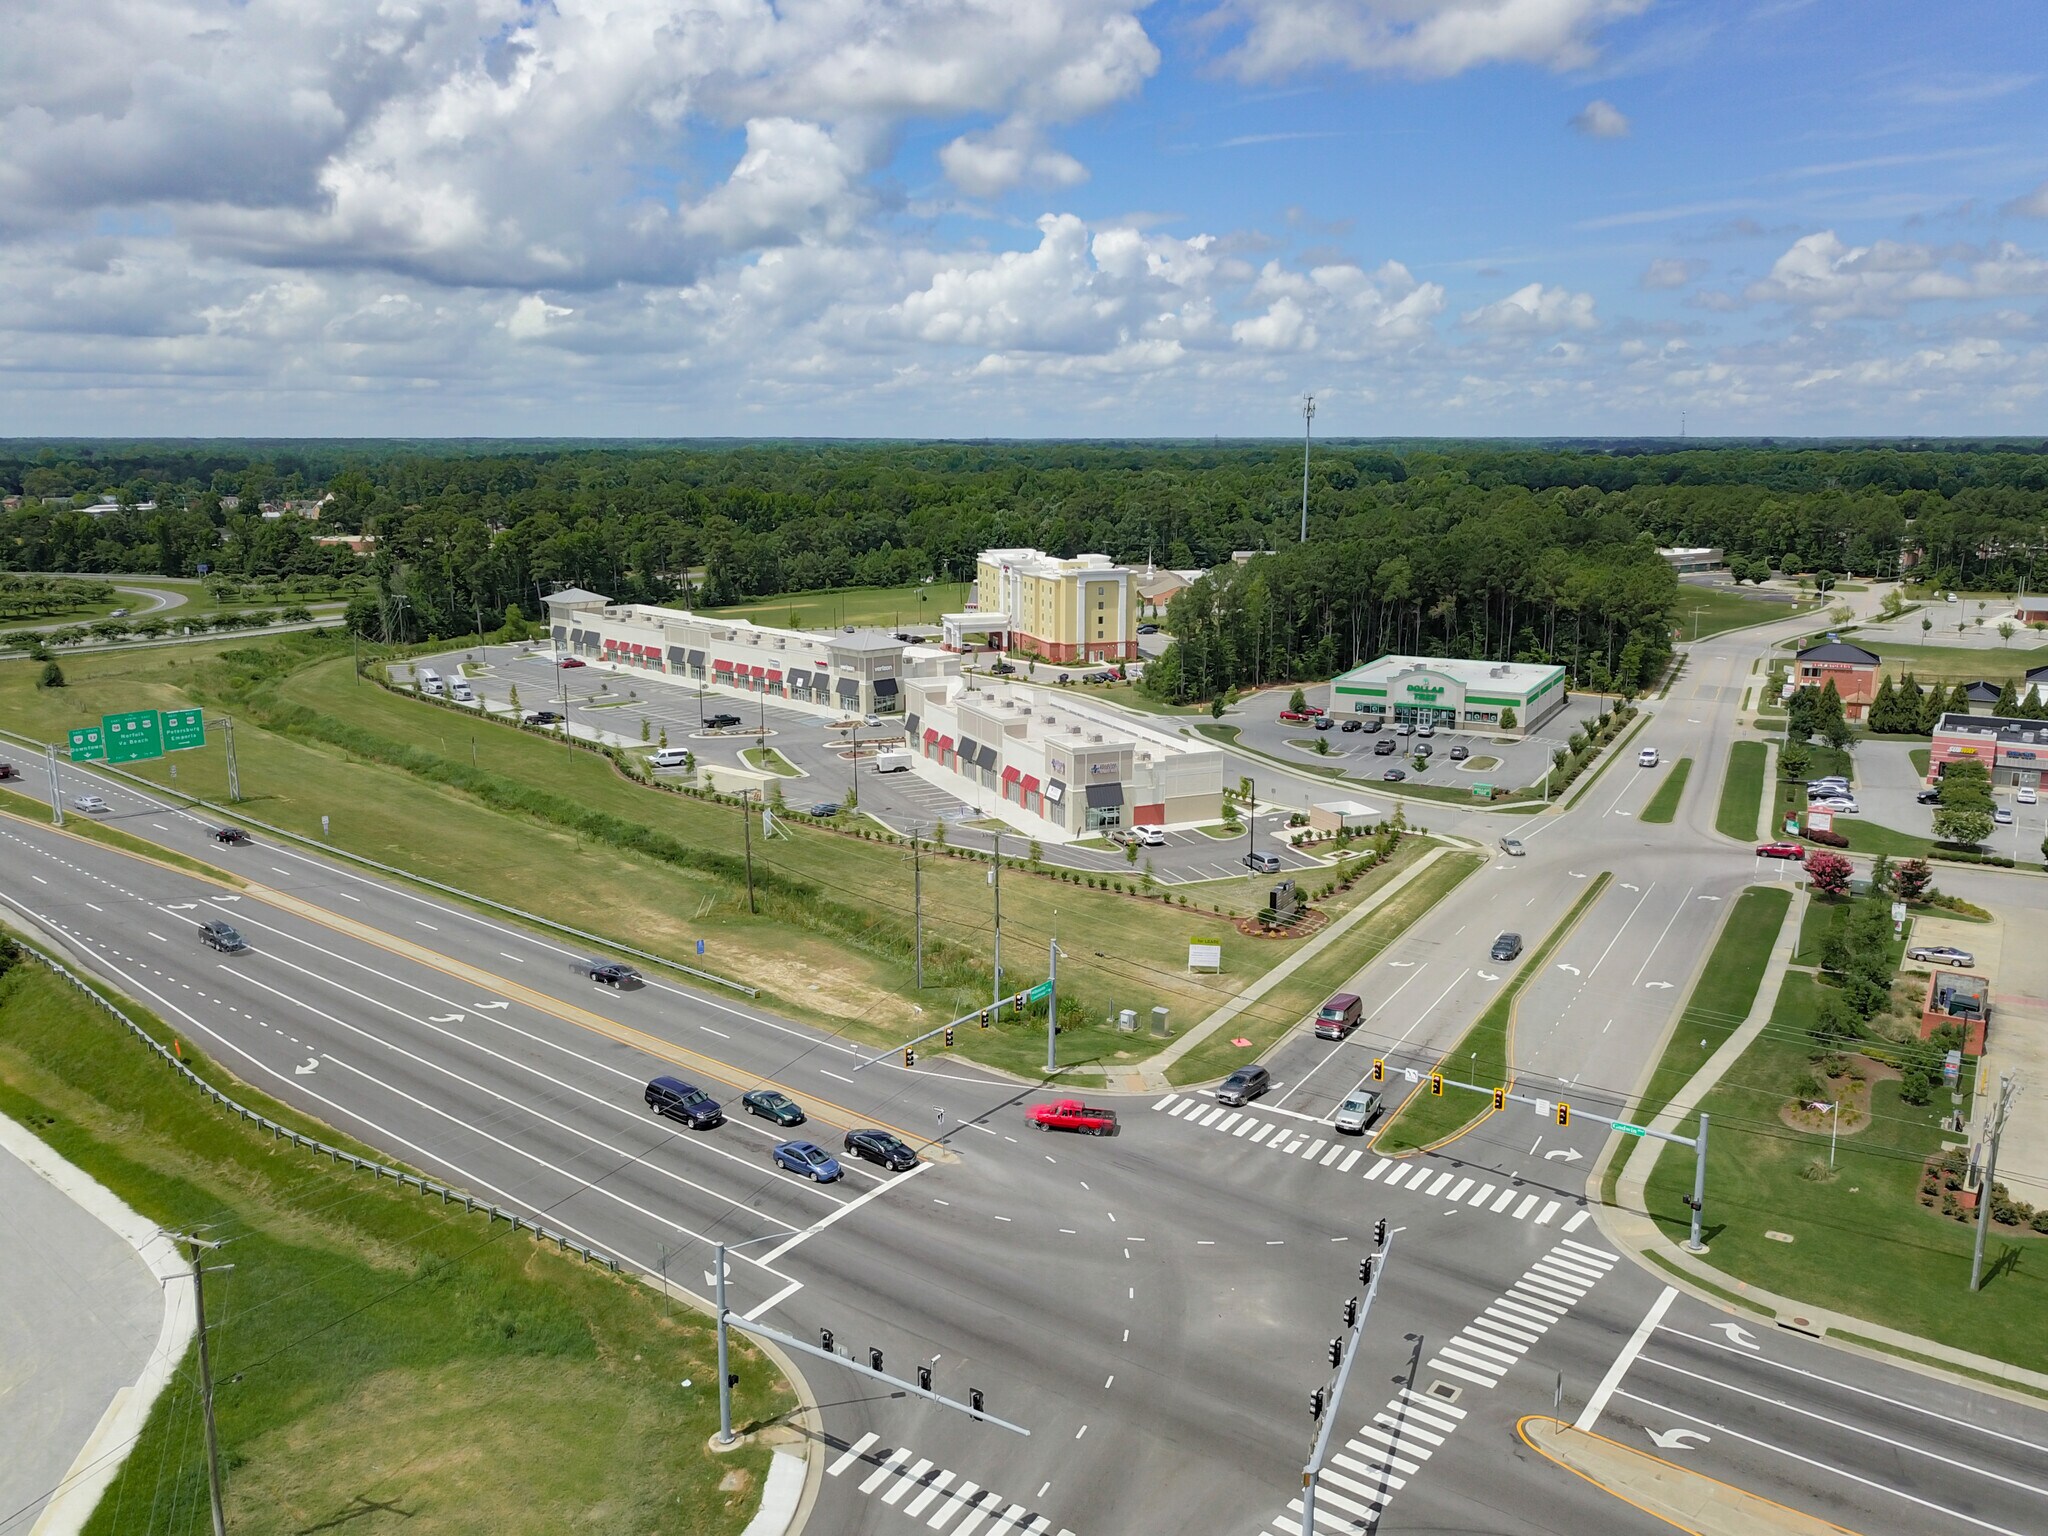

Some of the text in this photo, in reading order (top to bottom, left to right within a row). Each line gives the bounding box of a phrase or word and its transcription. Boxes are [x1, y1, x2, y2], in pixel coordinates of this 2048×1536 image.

[874, 664, 893, 672] verizon
[1407, 685, 1444, 694] DOLLAR
[166, 726, 200, 735] Petersburg
[120, 731, 144, 739] Norfolk
[170, 733, 197, 741] Emporia
[70, 744, 103, 753] Downtown
[1947, 746, 1978, 754] SUBWAY
